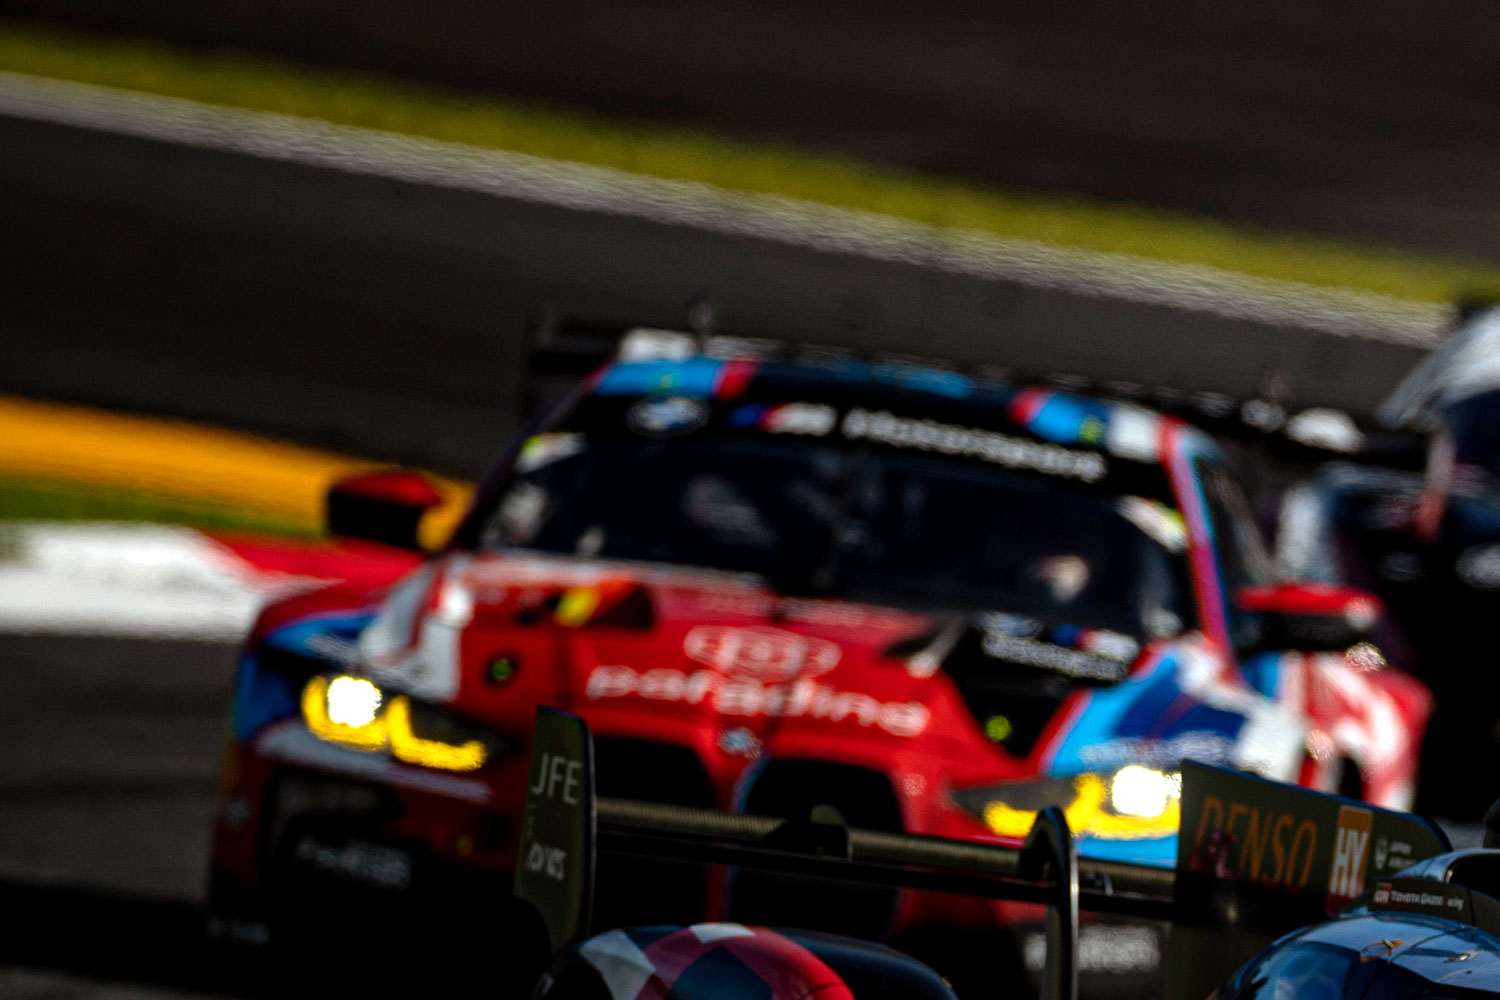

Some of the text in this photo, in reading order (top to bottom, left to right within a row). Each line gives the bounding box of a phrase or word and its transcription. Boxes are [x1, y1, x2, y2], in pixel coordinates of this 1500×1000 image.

[530, 752, 584, 806] JFE
[1189, 795, 1319, 898] DENSO
[1329, 826, 1369, 899] HY
